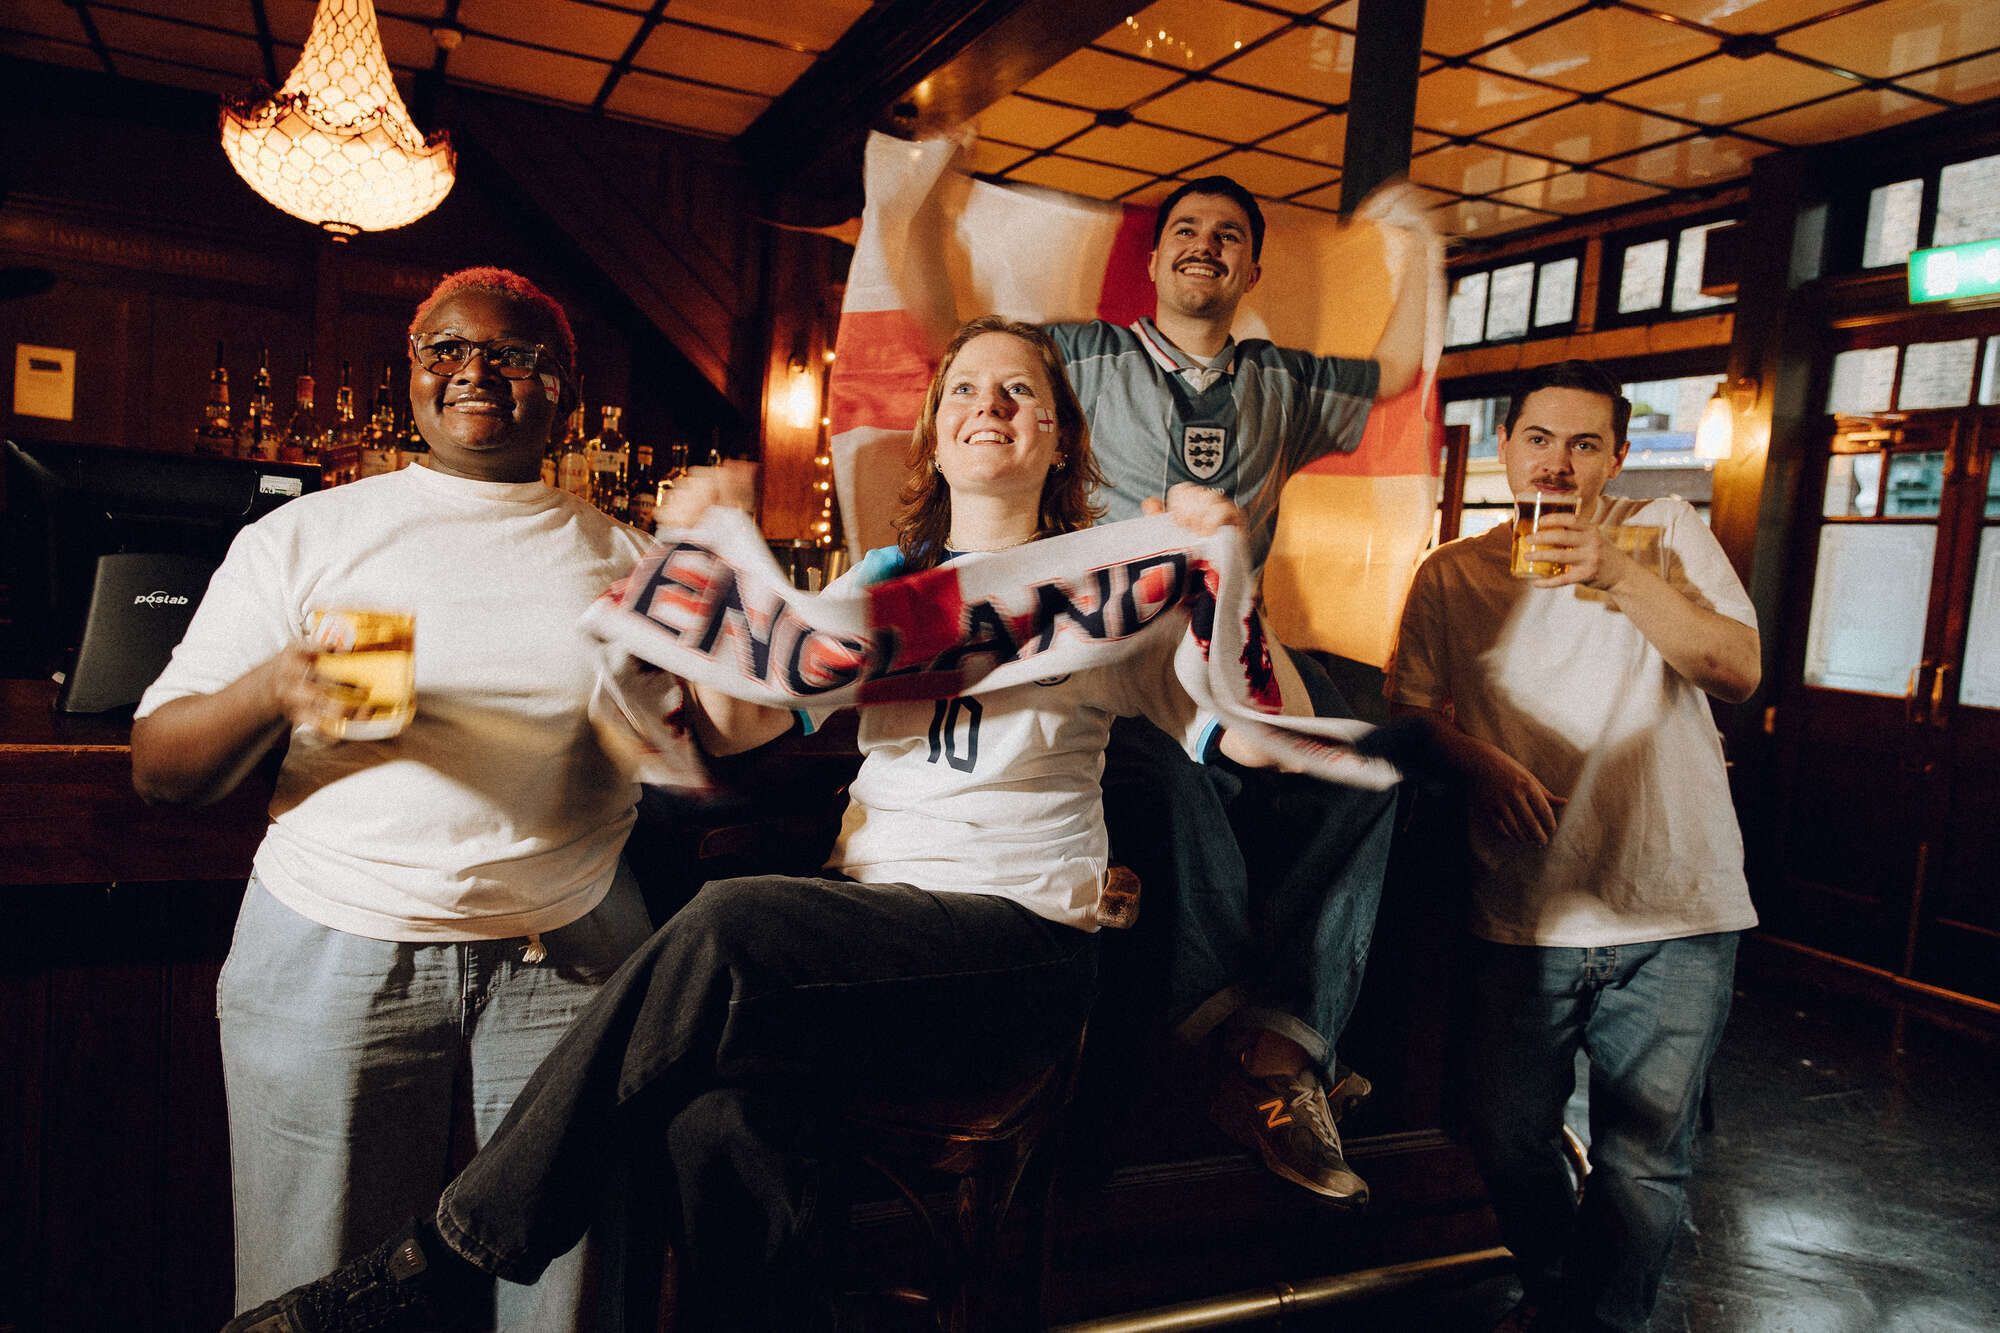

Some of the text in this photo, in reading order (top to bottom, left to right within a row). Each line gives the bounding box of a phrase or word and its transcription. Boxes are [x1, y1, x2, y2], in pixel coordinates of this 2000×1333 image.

[134, 590, 188, 608] poslab
[632, 541, 1190, 696] ENGLAND
[927, 694, 983, 774] 10
[1258, 1099, 1293, 1129] N
